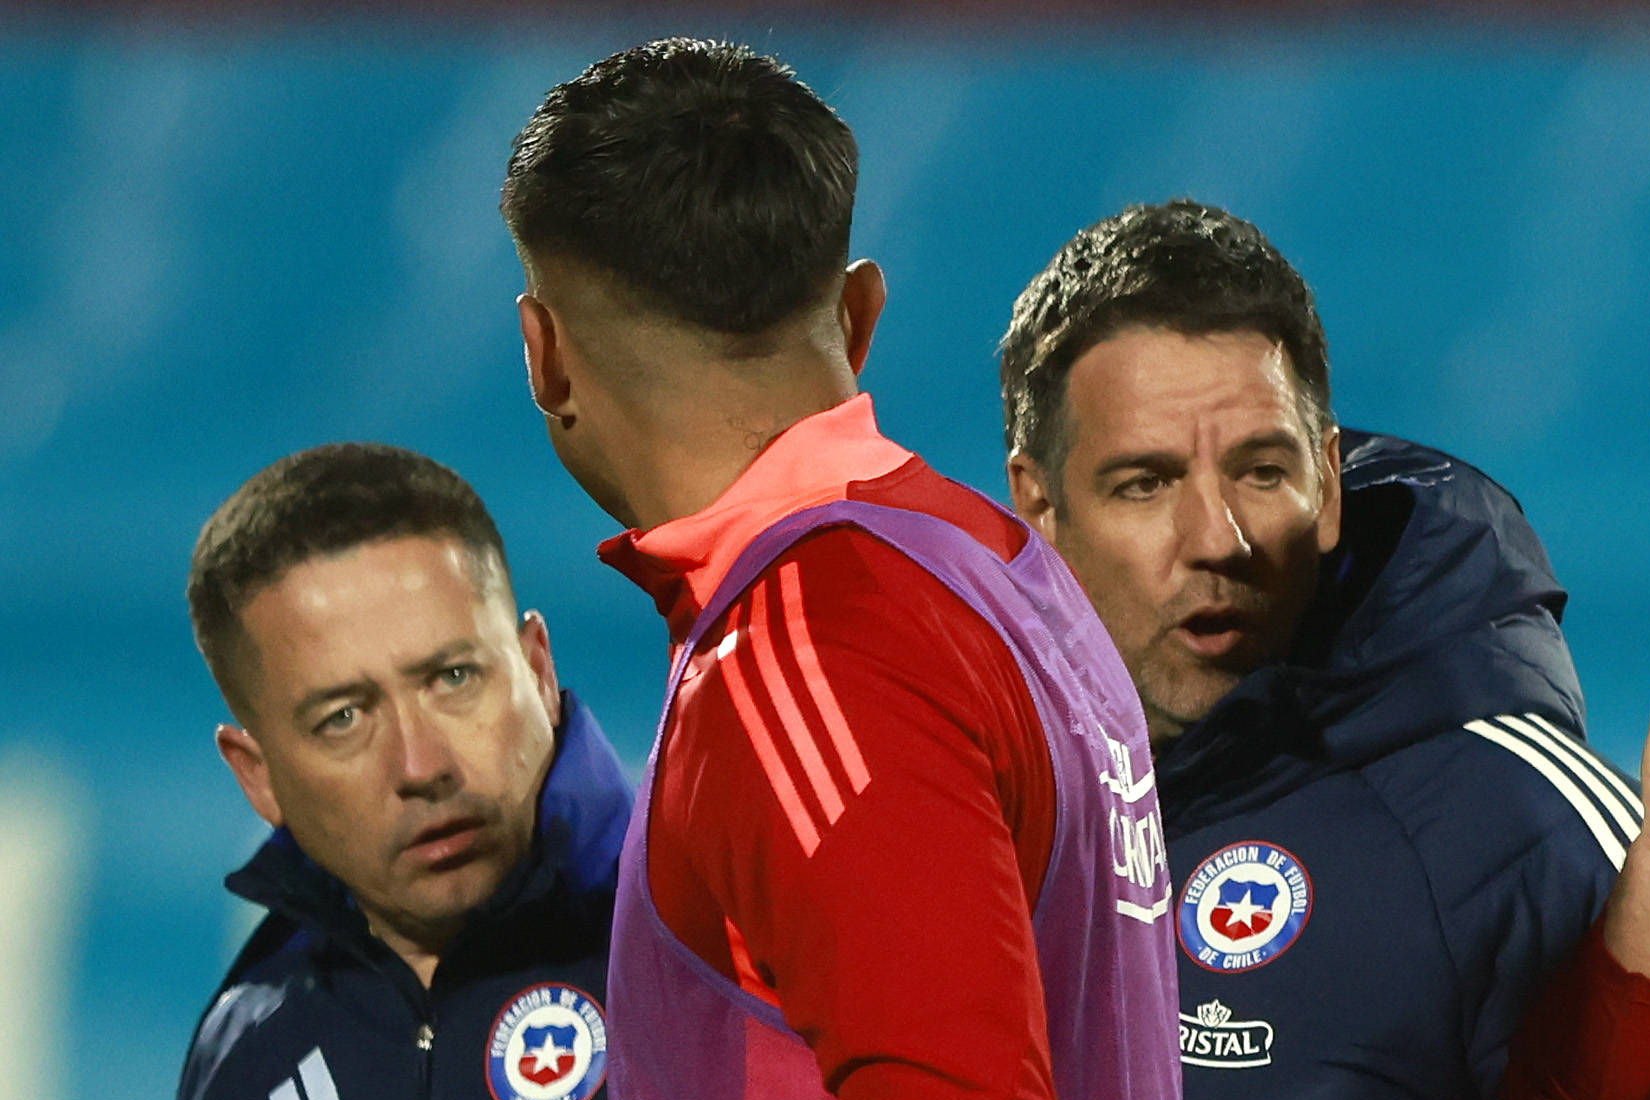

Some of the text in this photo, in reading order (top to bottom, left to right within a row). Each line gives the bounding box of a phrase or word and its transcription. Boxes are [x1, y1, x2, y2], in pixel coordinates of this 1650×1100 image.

[1184, 846, 1307, 916] FEDERACION DE FUTBOL
[1198, 947, 1262, 969] DE CHILE
[1179, 1024, 1260, 1056] RISTAL
